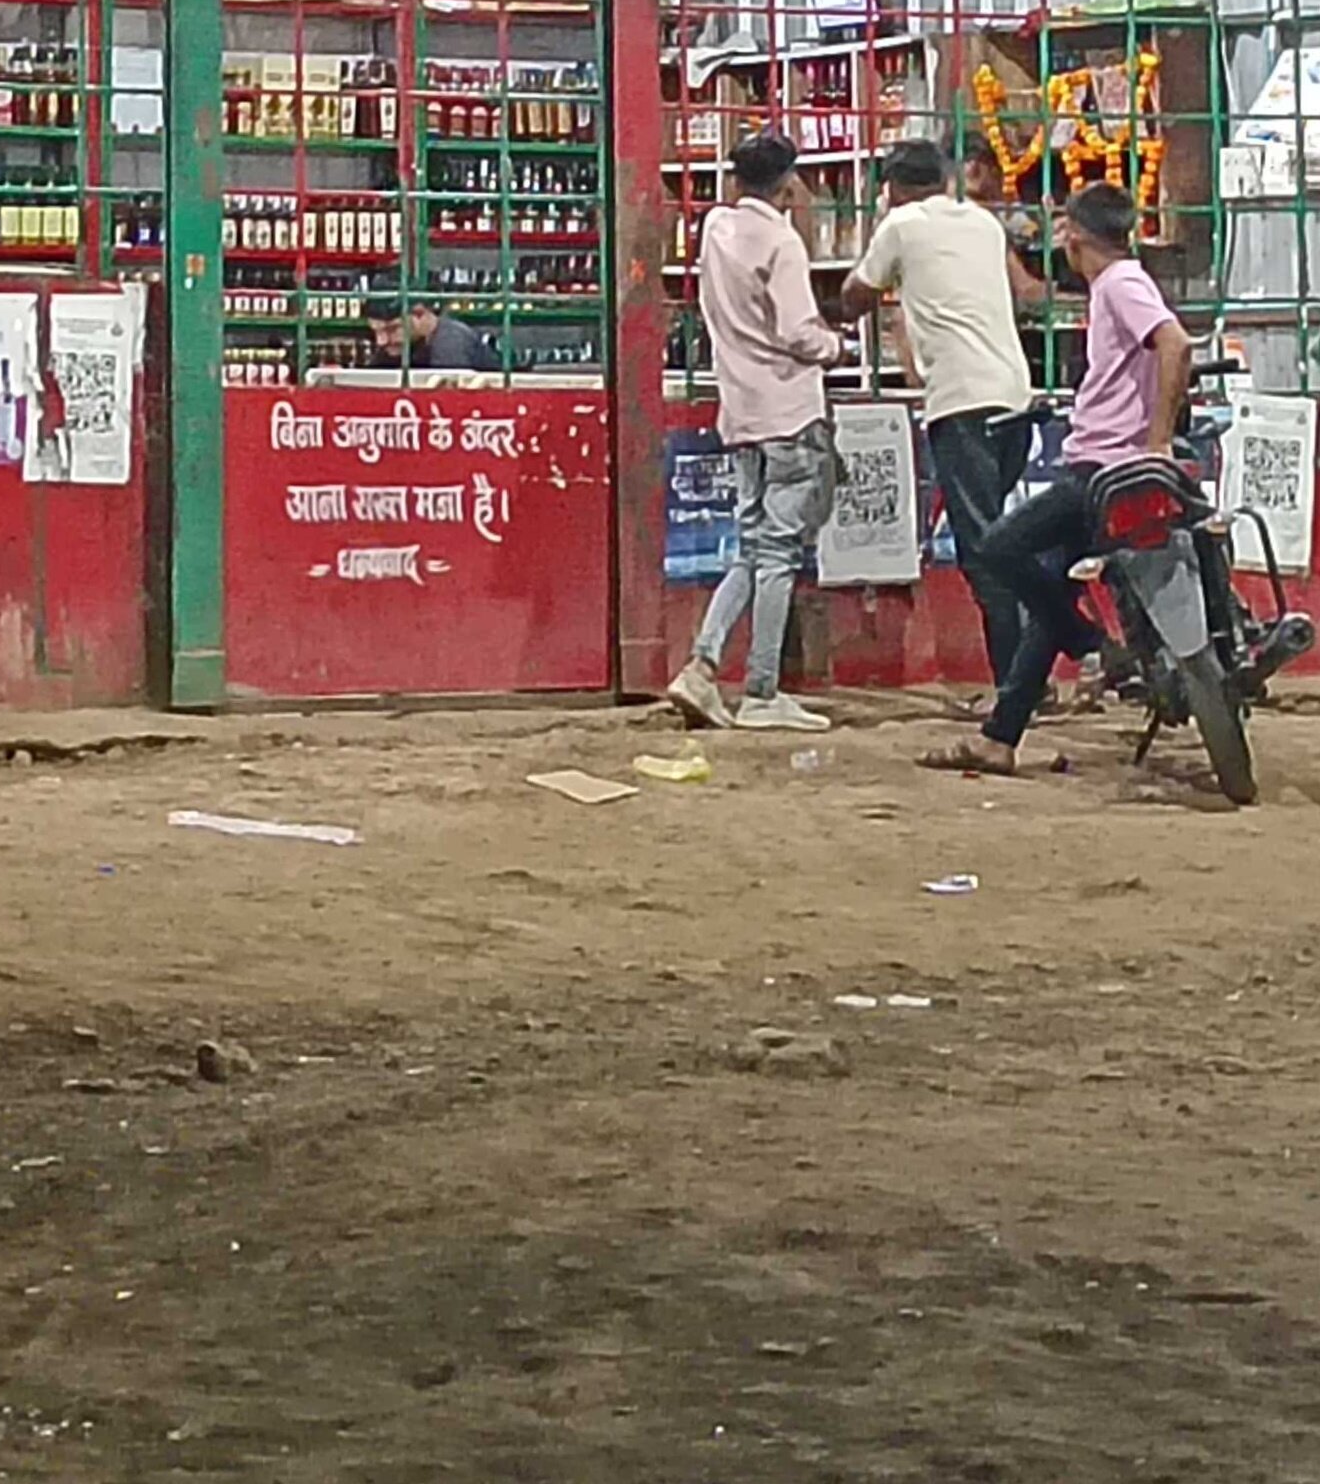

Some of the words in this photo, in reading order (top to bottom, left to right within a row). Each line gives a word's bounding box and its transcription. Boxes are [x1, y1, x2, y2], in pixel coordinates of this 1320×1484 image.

[271, 401, 323, 450] बिना
[332, 400, 420, 463] अनुमति
[428, 403, 452, 451] के
[285, 485, 347, 523] आना
[413, 485, 465, 523] मना
[337, 544, 425, 585] धन्यवाद
